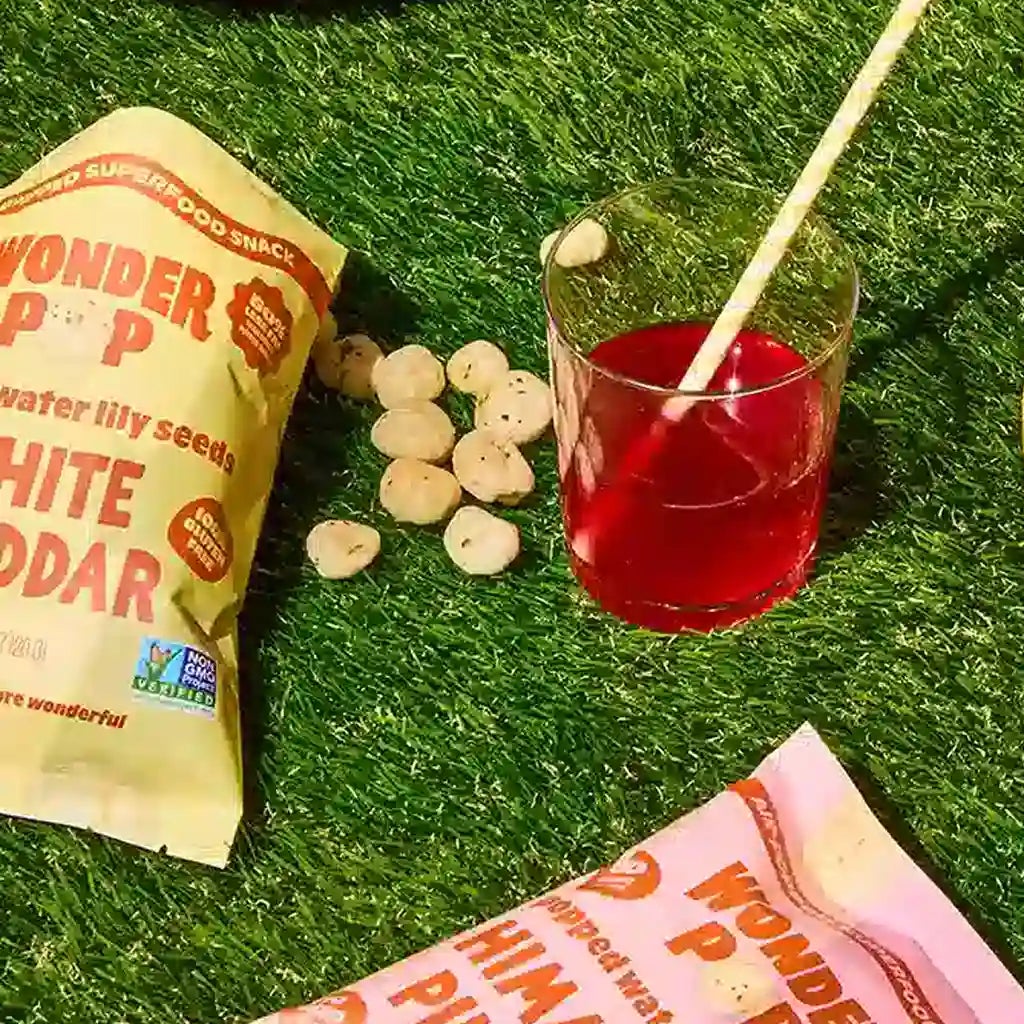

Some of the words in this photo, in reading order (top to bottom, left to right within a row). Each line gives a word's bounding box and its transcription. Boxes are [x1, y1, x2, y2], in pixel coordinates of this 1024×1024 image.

[85, 161, 228, 238] SUPERFOOD
[228, 226, 295, 266] SNACK
[94, 399, 152, 440] lily
[152, 418, 237, 477] seeds
[0, 436, 146, 529] HITE
[0, 521, 162, 624] DDAR
[137, 678, 214, 706] VERIFIED
[184, 662, 216, 684] GMO
[188, 650, 215, 673] NON
[27, 695, 128, 729] wonderful
[684, 860, 877, 1024] WONDE
